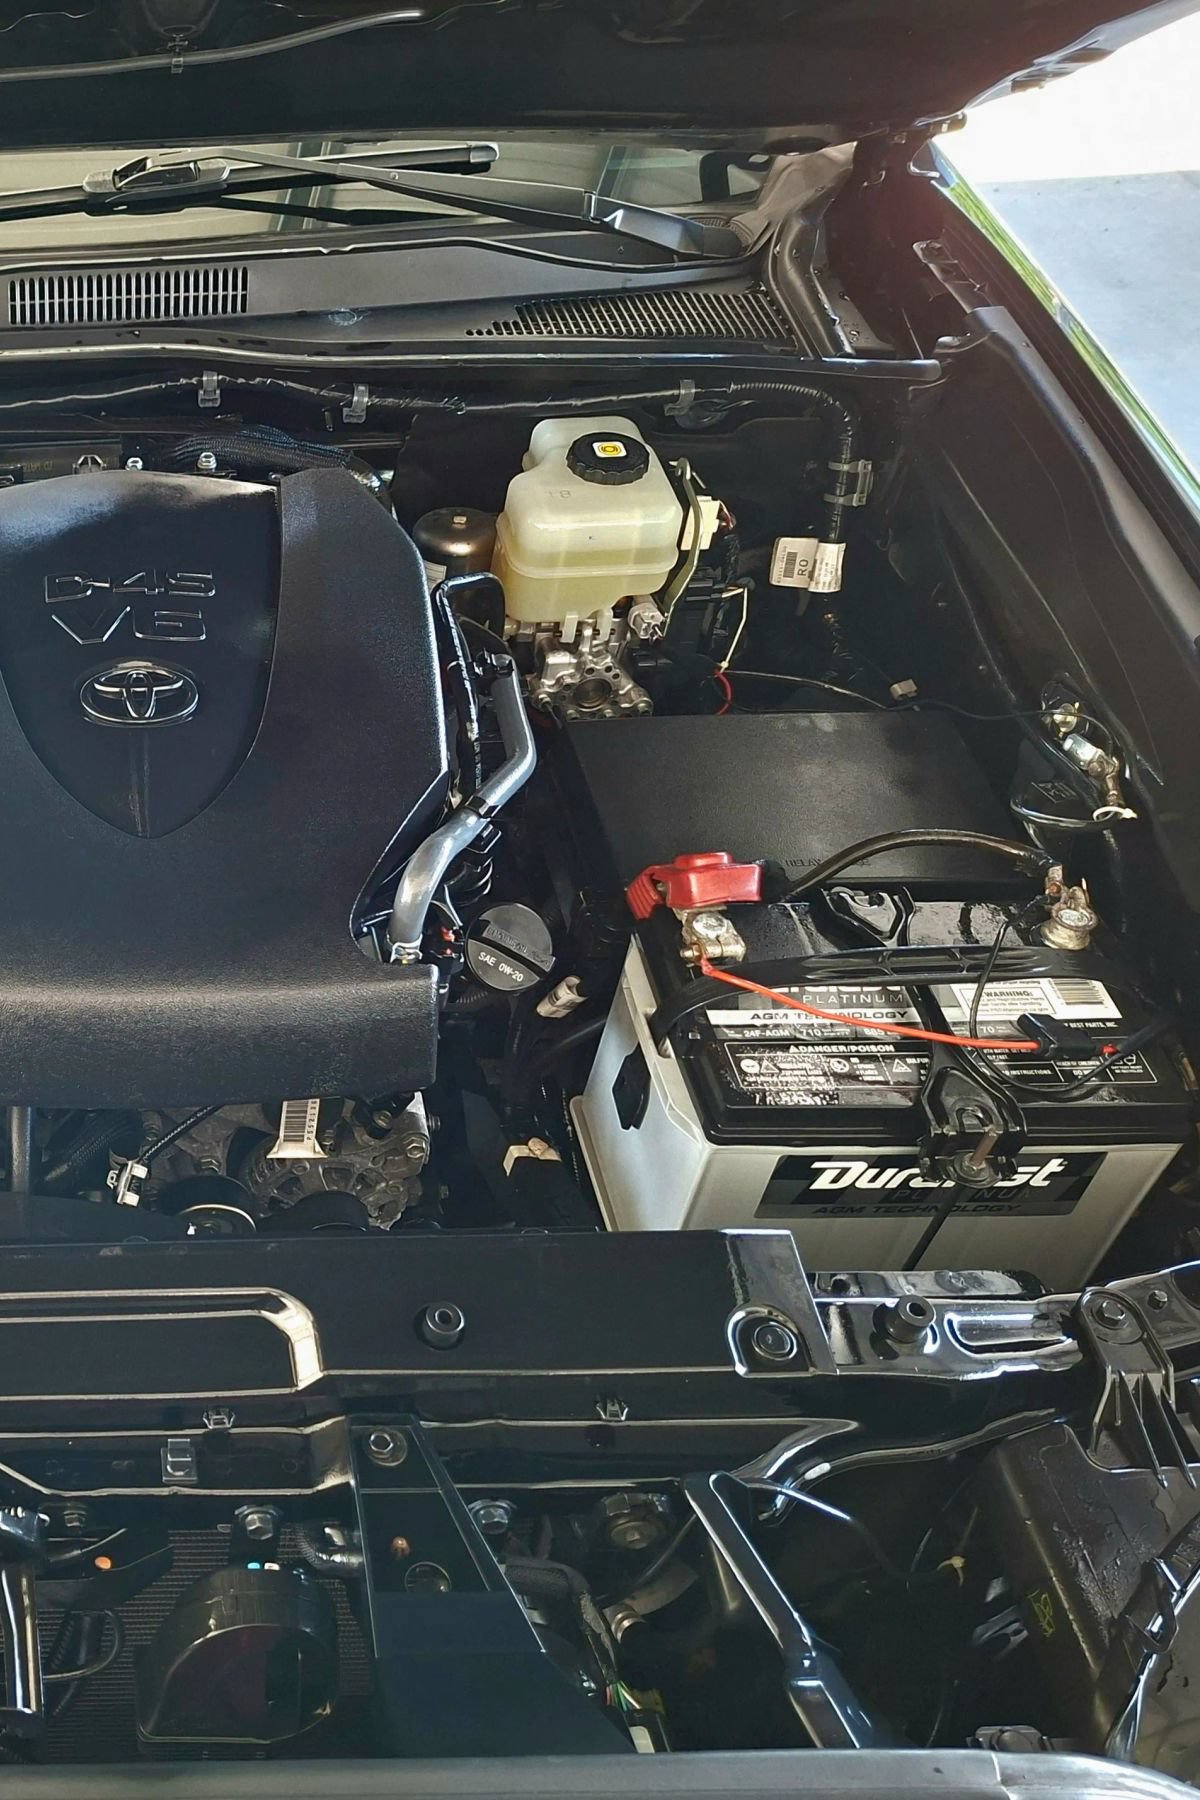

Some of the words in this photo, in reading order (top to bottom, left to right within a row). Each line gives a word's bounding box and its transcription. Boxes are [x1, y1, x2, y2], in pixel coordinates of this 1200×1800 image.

[51, 606, 206, 645] V6
[478, 951, 497, 967] SAE
[802, 994, 904, 1004] PLATINUM
[750, 1012, 789, 1020] AGM
[808, 1158, 1066, 1190] Durst
